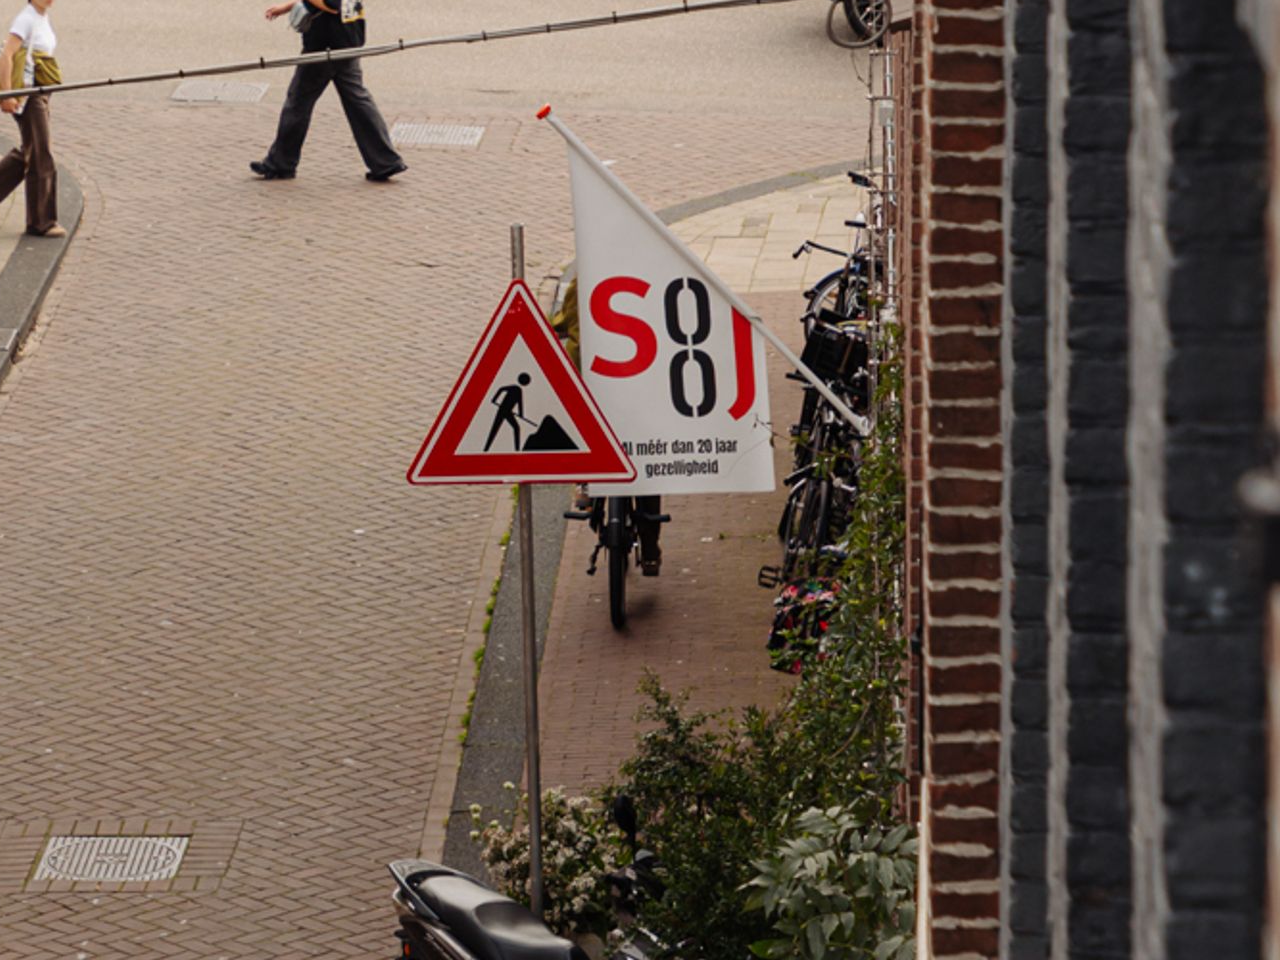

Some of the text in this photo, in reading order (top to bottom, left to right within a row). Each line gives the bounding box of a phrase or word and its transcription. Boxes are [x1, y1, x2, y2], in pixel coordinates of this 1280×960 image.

[671, 439, 695, 455] dan
[697, 438, 713, 454] 20
[715, 437, 738, 454] jaar
[645, 459, 719, 479] gezelligheid
